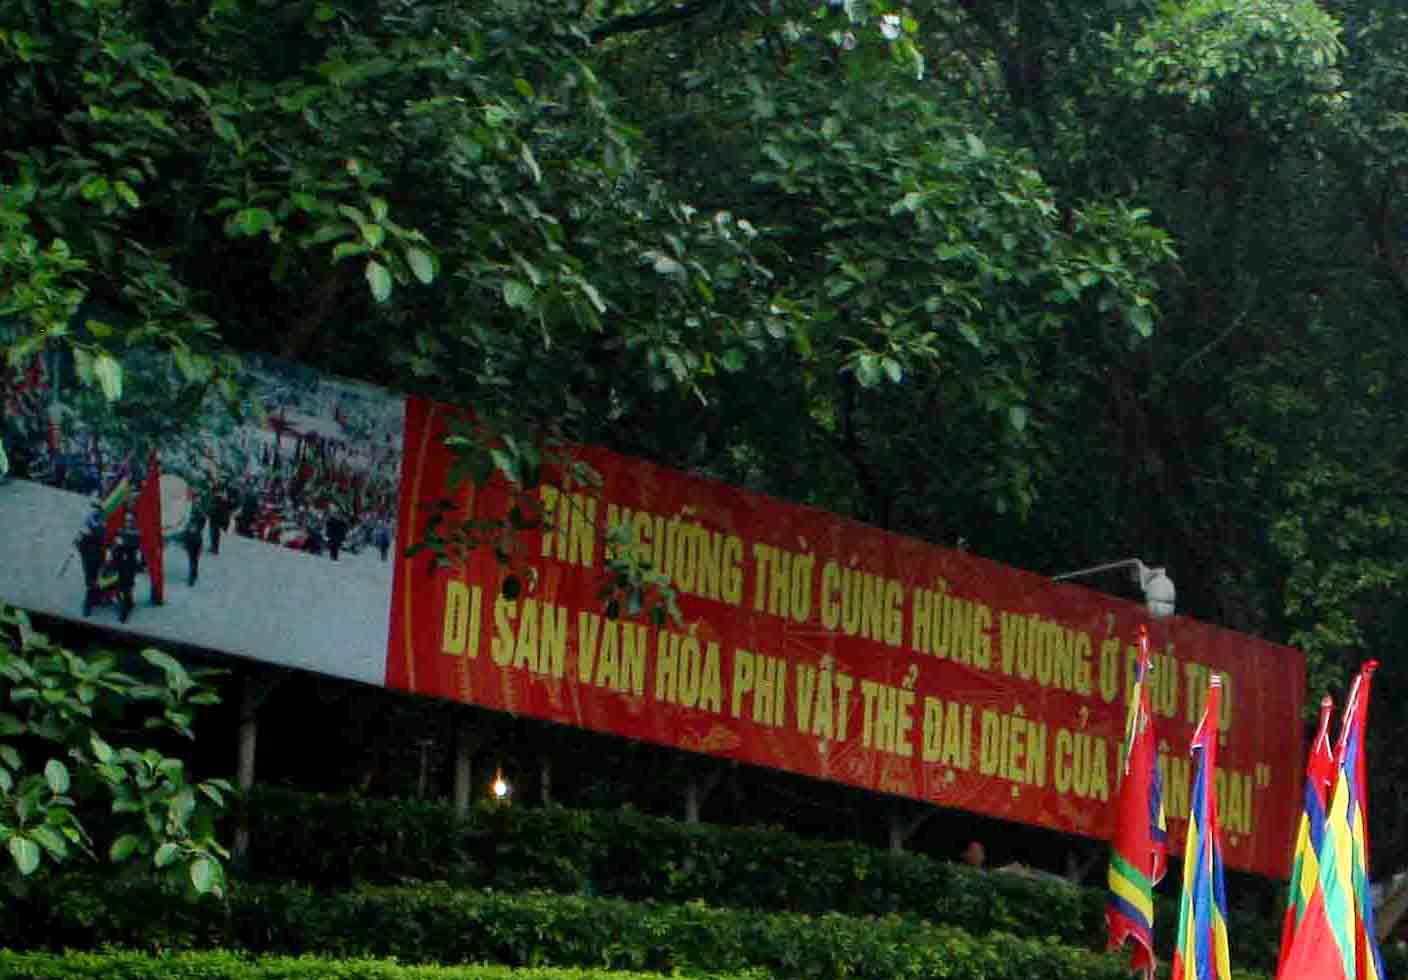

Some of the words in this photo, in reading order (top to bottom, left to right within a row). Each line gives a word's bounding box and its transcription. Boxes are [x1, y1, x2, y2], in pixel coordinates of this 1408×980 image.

[441, 579, 482, 659] DI
[731, 648, 787, 728] PHI
[795, 654, 854, 753] VẬT
[921, 694, 973, 785] ĐẠI
[980, 705, 1047, 799] DIỆN
[752, 536, 816, 624] THỜ
[820, 554, 905, 647] CÚNG
[911, 577, 993, 671] HÙNG
[1000, 609, 1093, 695] VƯƠNG
